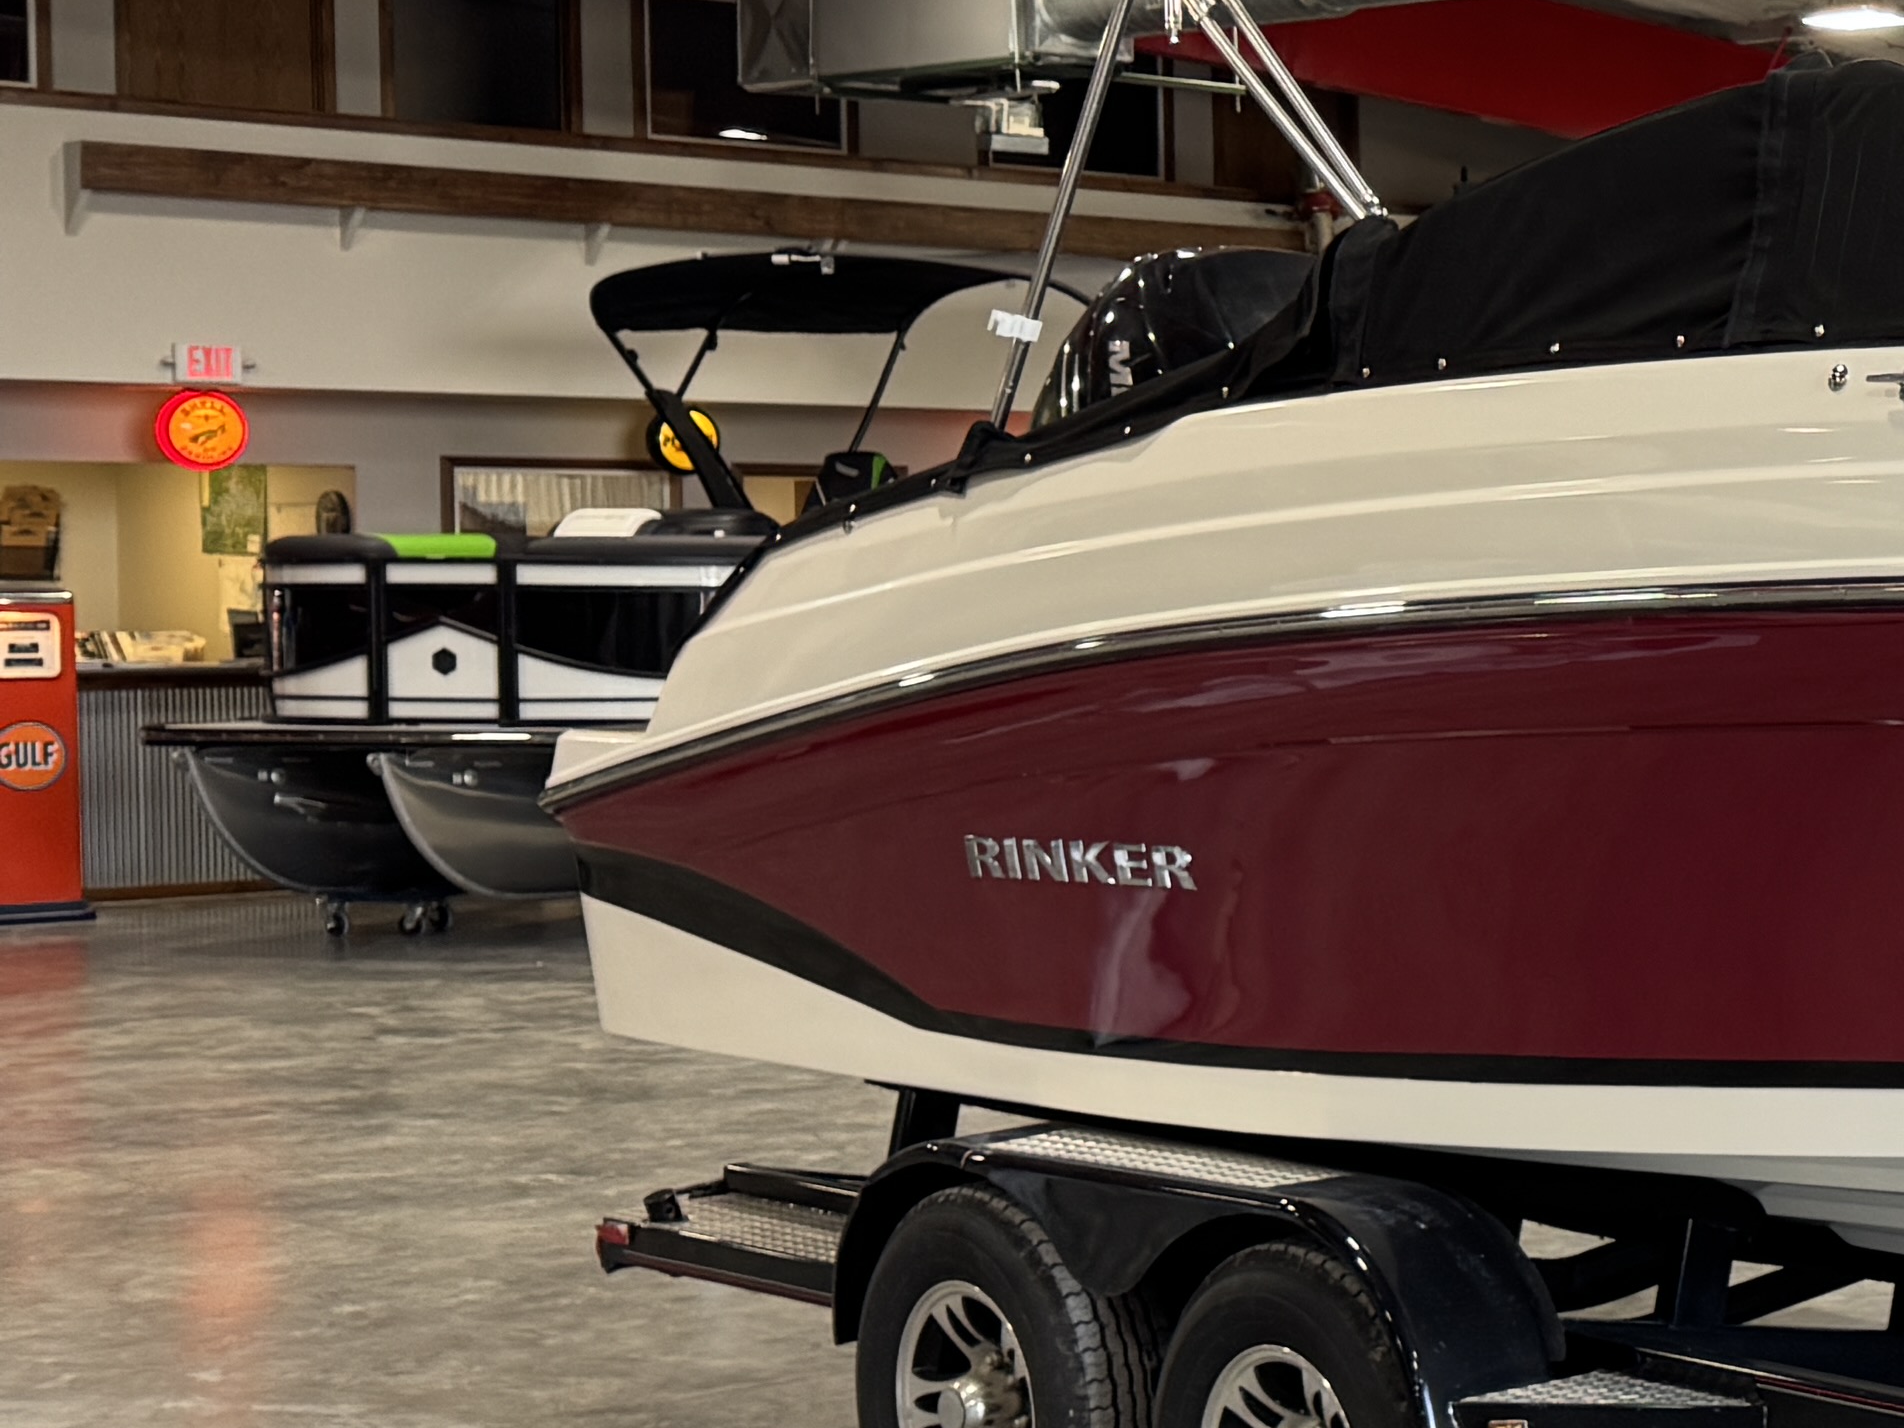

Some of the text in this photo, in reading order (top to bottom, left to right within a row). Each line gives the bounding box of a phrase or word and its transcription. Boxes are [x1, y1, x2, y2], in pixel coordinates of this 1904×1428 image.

[187, 345, 233, 379] EXIT
[0, 740, 56, 770] GULF
[964, 834, 1198, 891] RINKER
